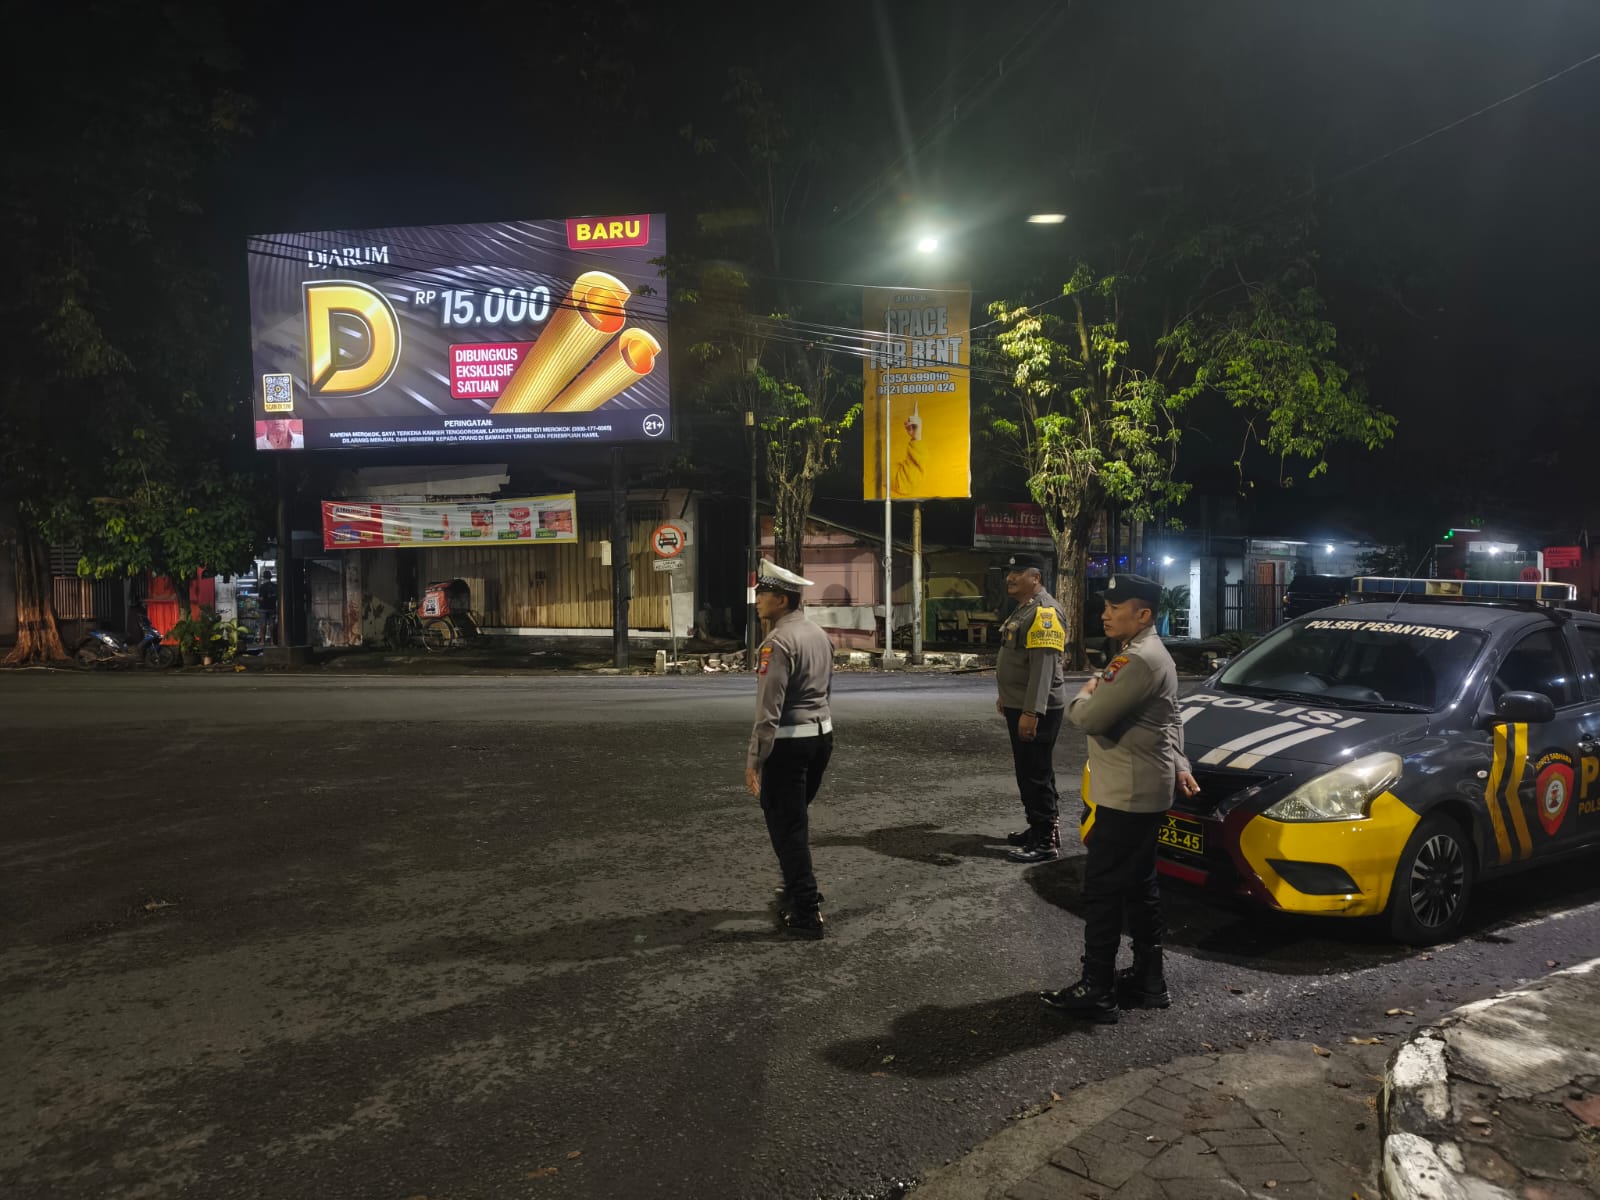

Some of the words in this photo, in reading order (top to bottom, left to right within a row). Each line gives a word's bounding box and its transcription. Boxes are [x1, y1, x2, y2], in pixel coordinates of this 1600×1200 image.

[576, 220, 640, 241] BARU
[307, 245, 390, 270] DJARUM
[415, 290, 436, 304] RP
[441, 286, 550, 324] 15.000
[884, 305, 948, 337] SPACE
[303, 281, 401, 398] D
[455, 348, 518, 362] DIBUNGKUS
[870, 341, 907, 369] FOR
[911, 337, 962, 368] RENT
[456, 364, 514, 378] EKSKLUSIF
[457, 380, 499, 393] SATUAN
[902, 383, 934, 393] 80000
[937, 382, 955, 392] 424
[645, 421, 663, 430] 21+
[1304, 620, 1363, 630] POLSEK
[1362, 621, 1460, 641] PESANTREN
[1178, 694, 1366, 729] POLISI
